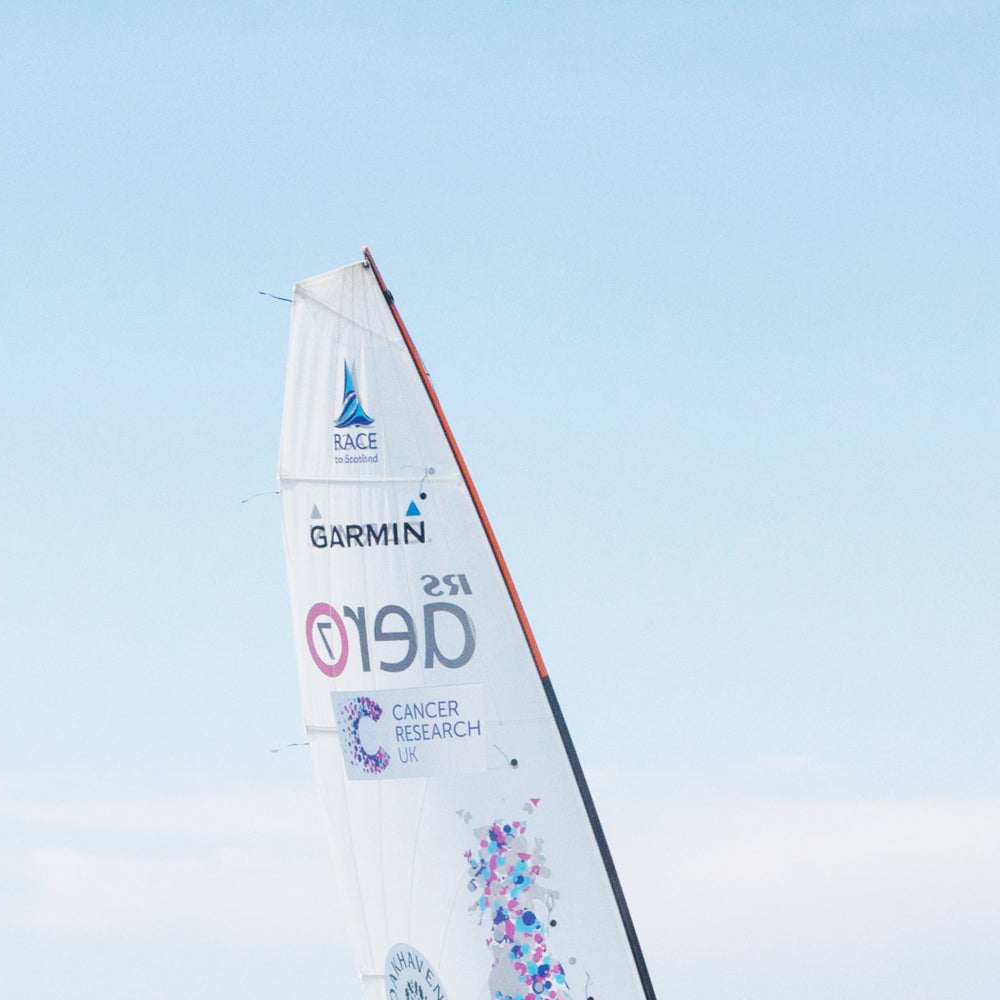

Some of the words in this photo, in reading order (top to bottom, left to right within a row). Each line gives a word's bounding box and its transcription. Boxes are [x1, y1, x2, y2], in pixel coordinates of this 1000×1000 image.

[333, 432, 378, 451] RACE
[334, 455, 343, 464] to
[344, 453, 378, 464] Scotland
[310, 520, 425, 549] GARMIN
[392, 700, 460, 721] CANCER
[395, 719, 481, 742] RESEARCH
[397, 746, 419, 764] UK
